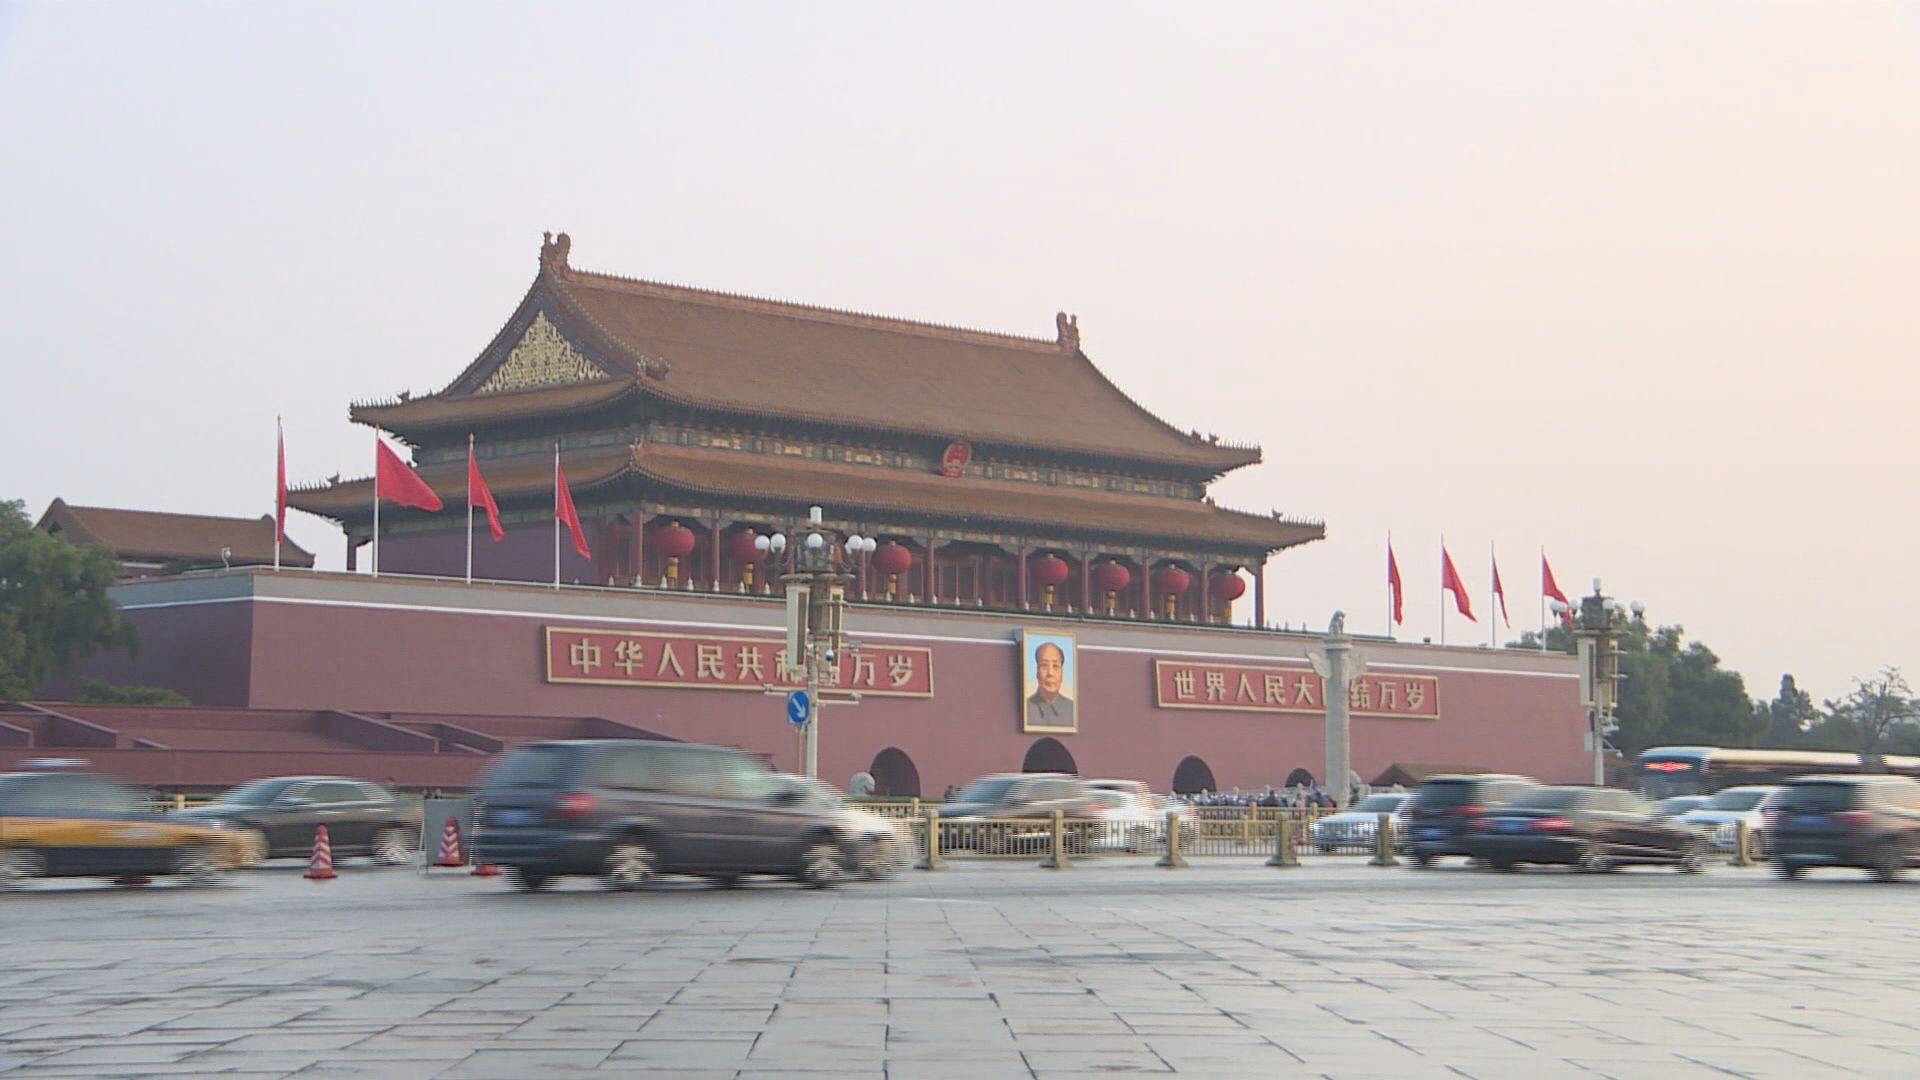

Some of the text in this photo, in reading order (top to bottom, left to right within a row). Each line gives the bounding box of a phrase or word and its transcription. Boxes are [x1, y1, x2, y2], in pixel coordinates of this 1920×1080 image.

[1174, 669, 1425, 710] 世界人民大结万岁
